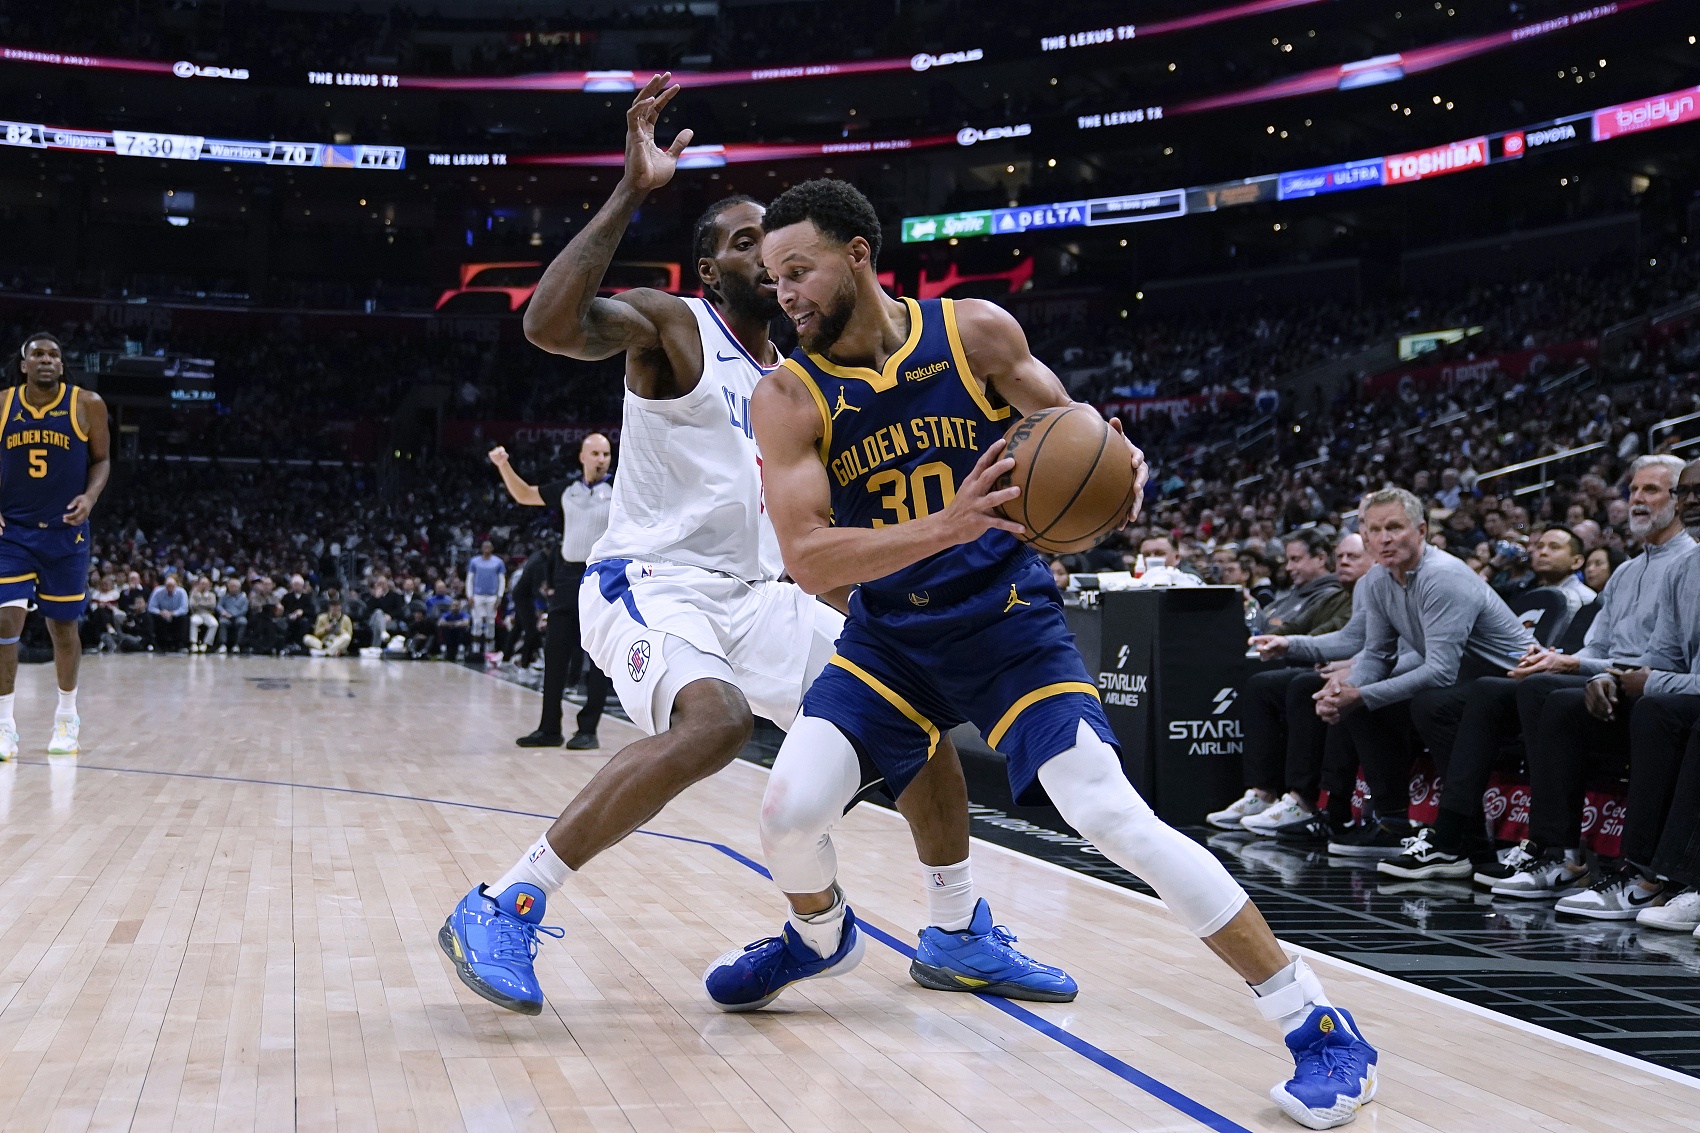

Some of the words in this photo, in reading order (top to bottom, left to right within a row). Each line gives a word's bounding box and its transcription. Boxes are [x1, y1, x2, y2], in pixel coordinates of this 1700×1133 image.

[1041, 35, 1067, 51] THE
[1069, 28, 1114, 48] LEXUS
[1117, 25, 1136, 41] TX
[931, 48, 983, 66] LEXUS
[194, 65, 249, 80] LEXUS
[308, 71, 333, 85] THE
[336, 72, 378, 87] LEXUS
[381, 74, 399, 87] TX
[1078, 114, 1102, 129] THE
[1103, 109, 1144, 126] LEXUS
[1146, 106, 1163, 120] TX
[1617, 96, 1693, 126] boldyn
[6, 124, 33, 145] 82
[54, 132, 107, 148] Clippers
[977, 123, 1032, 141] LEXUS
[1525, 124, 1576, 147] TOYOTA
[125, 135, 173, 156] 7:30
[209, 144, 262, 159] Warriors
[281, 146, 307, 164] 70
[428, 153, 451, 166] THE
[452, 153, 490, 166] LEXUS
[492, 153, 507, 165] TX
[1388, 143, 1482, 180] TOSHIBA
[1334, 166, 1379, 185] ULTRA
[942, 216, 985, 236] Sprite
[1018, 207, 1081, 226] DELTA
[905, 360, 949, 382] Rakuten
[6, 429, 41, 450] GOLDEN
[42, 429, 70, 450] STATE
[831, 422, 909, 487] GOLDEN
[910, 416, 978, 451] STATE
[28, 449, 48, 479] 5
[866, 461, 956, 529] 30
[1100, 672, 1147, 693] STARLUX
[1105, 692, 1139, 707] AIRLINES
[1168, 720, 1244, 740] STARL
